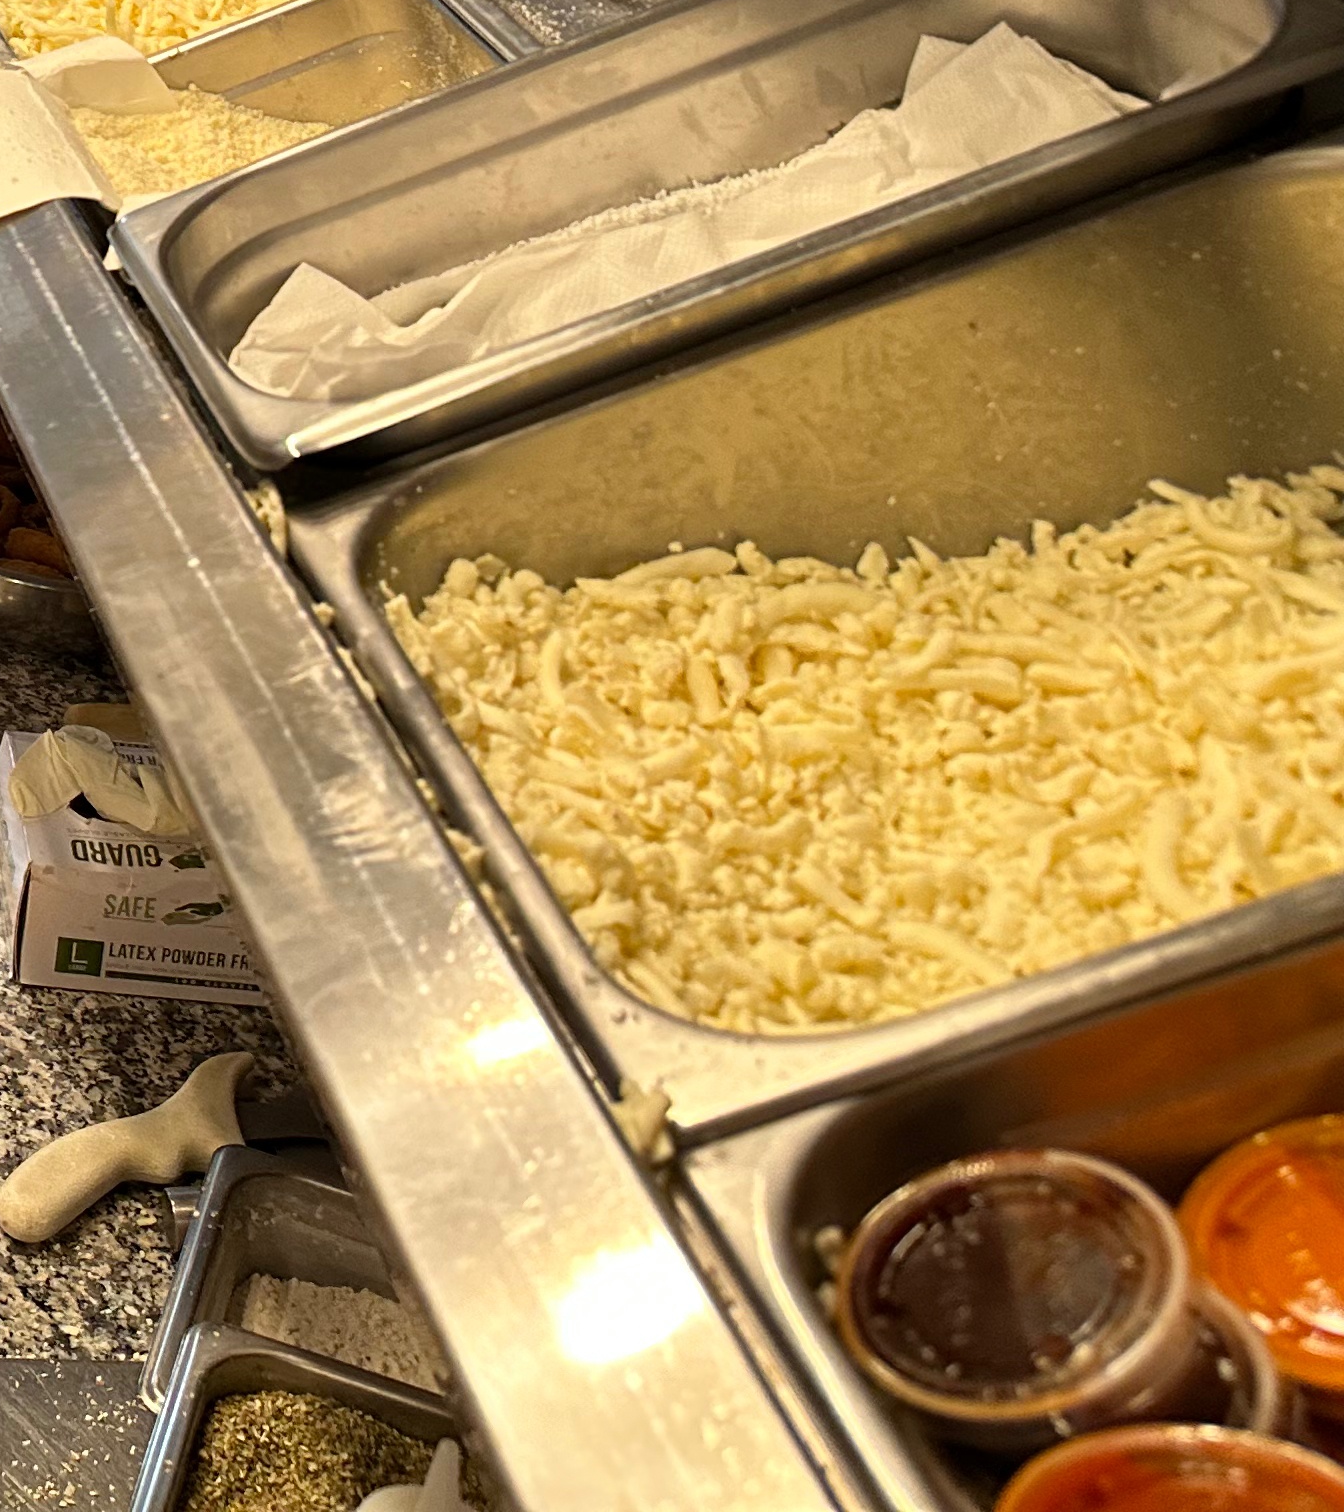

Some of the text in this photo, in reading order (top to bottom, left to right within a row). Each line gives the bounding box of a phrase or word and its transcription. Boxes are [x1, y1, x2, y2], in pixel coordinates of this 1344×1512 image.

[70, 838, 163, 868] GUARD
[102, 893, 157, 919] SAFE
[70, 941, 89, 965] L
[108, 941, 158, 963] LATEX
[161, 946, 227, 970] POWDER
